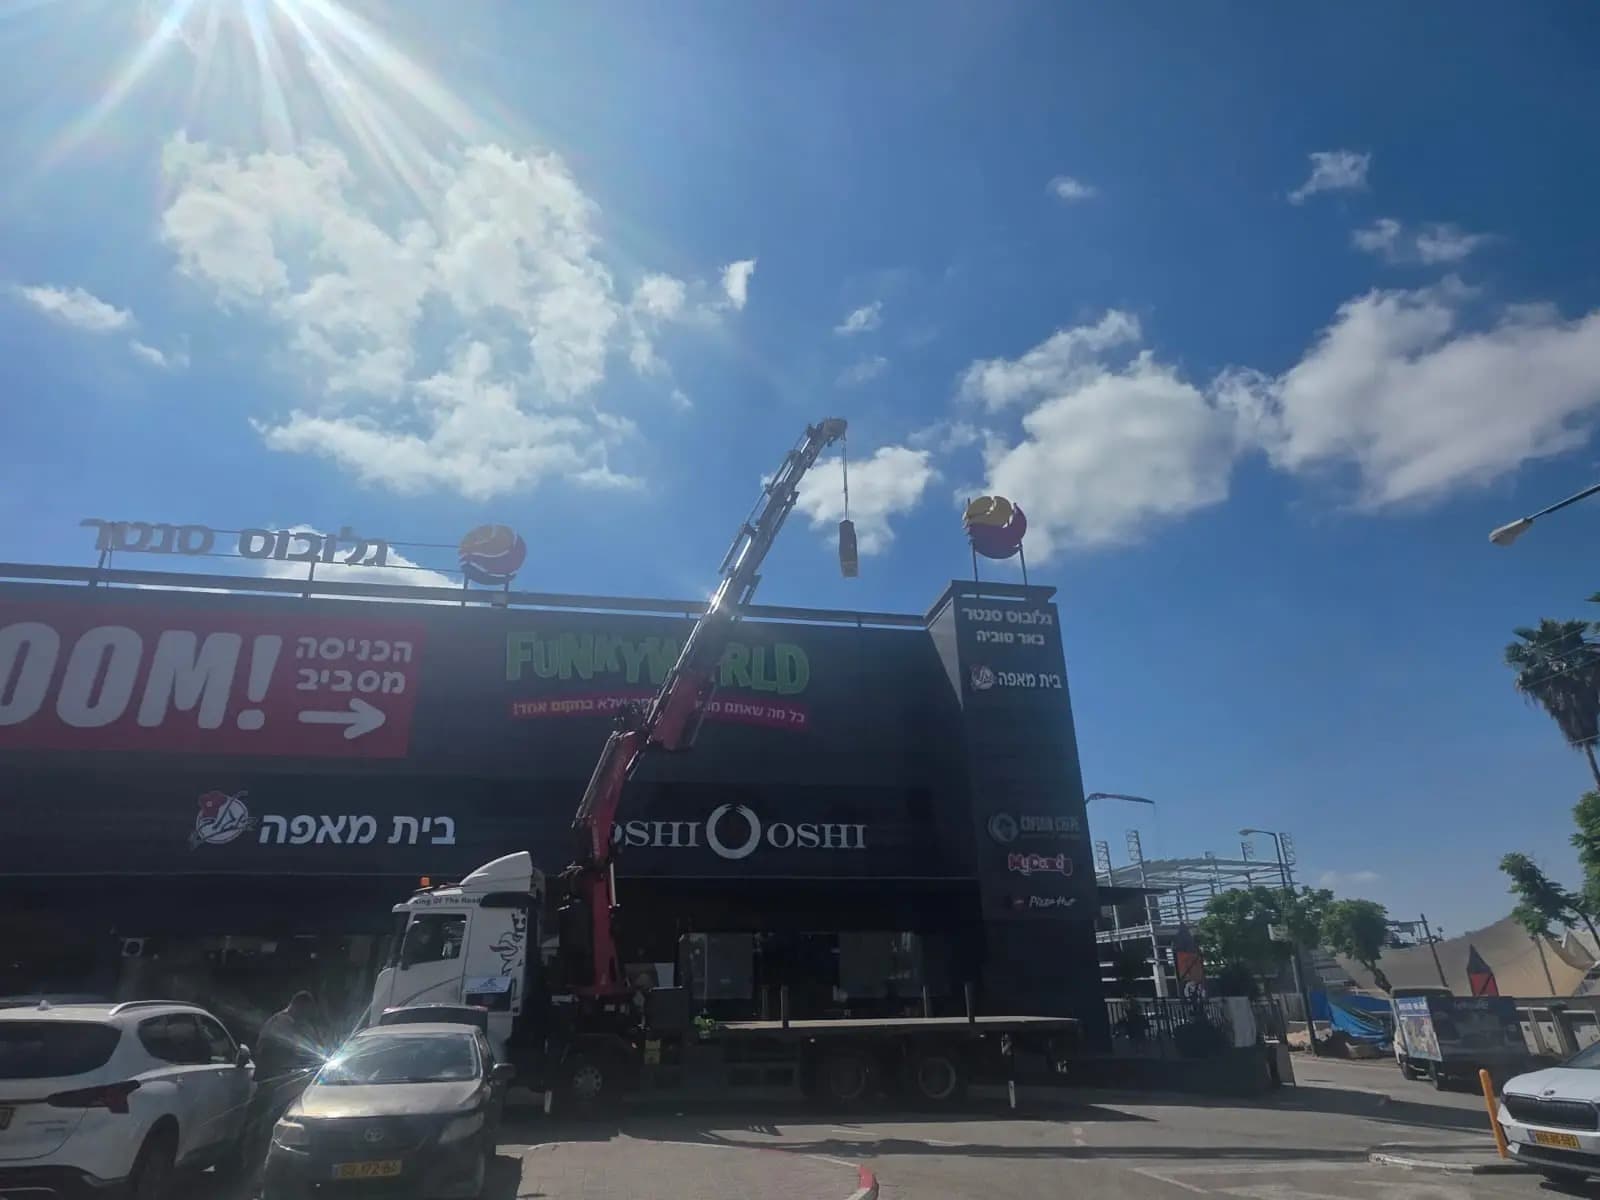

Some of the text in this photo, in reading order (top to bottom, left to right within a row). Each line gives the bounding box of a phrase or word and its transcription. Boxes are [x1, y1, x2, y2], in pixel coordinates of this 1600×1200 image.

[80, 518, 387, 566] גלובוס סנטר
[962, 608, 1052, 625] גלובוס סנטר
[296, 636, 412, 663] הכניסה
[1017, 632, 1044, 645] באר
[506, 632, 811, 695] FUNKYWRLD
[296, 668, 406, 694] מסביב
[999, 671, 1062, 689] בית מאפה
[789, 708, 805, 723] כל
[258, 814, 456, 846] בית מאפה
[766, 822, 868, 849] OSHI
